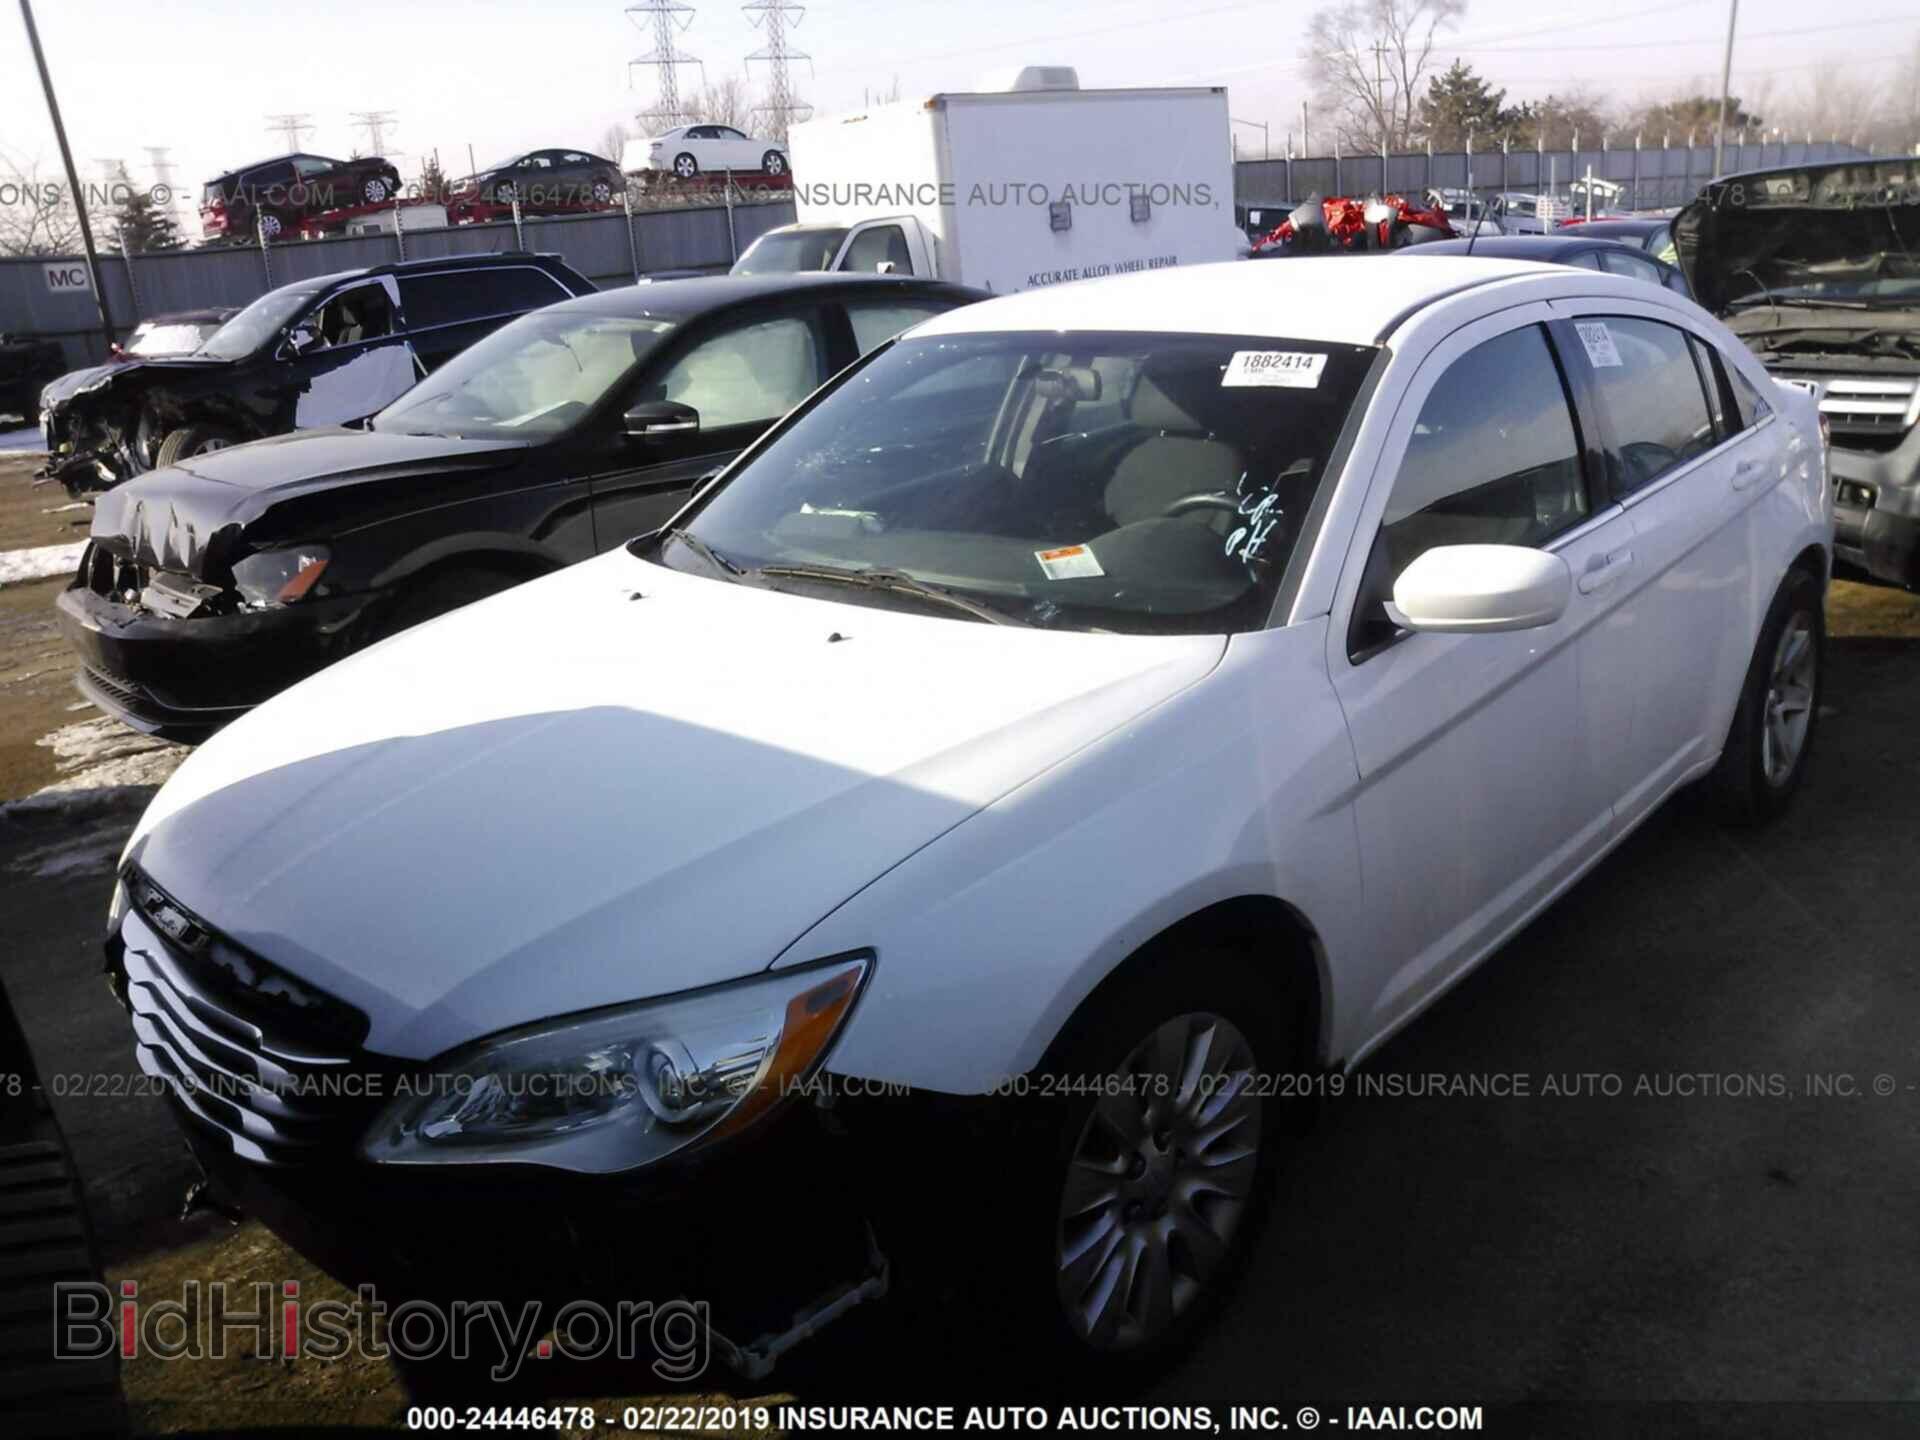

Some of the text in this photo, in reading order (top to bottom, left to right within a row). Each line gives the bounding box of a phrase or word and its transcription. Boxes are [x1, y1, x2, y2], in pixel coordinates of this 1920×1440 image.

[49, 269, 85, 286] MC
[1028, 268, 1079, 287] ACCURATE
[1082, 264, 1111, 280] ALLOY
[1114, 259, 1145, 274] WHEEL
[1148, 255, 1178, 269] REPAIR
[1243, 354, 1313, 369] 1882414
